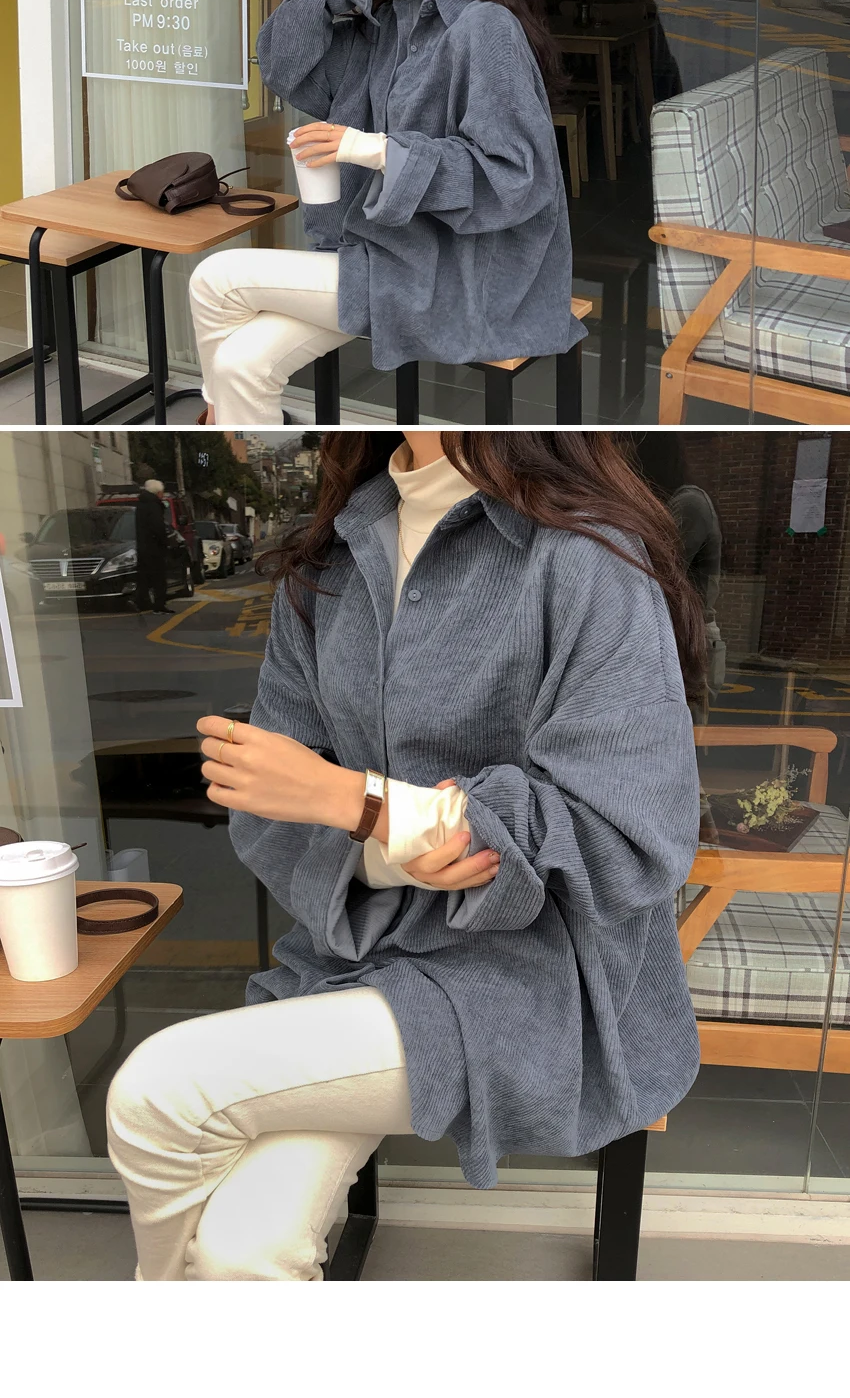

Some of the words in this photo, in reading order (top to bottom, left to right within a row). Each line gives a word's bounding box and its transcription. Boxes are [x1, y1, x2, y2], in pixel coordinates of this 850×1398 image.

[156, 14, 191, 30] 9:30
[116, 39, 148, 53] Take
[126, 59, 167, 73] 1000원
[174, 61, 198, 76] 할인
